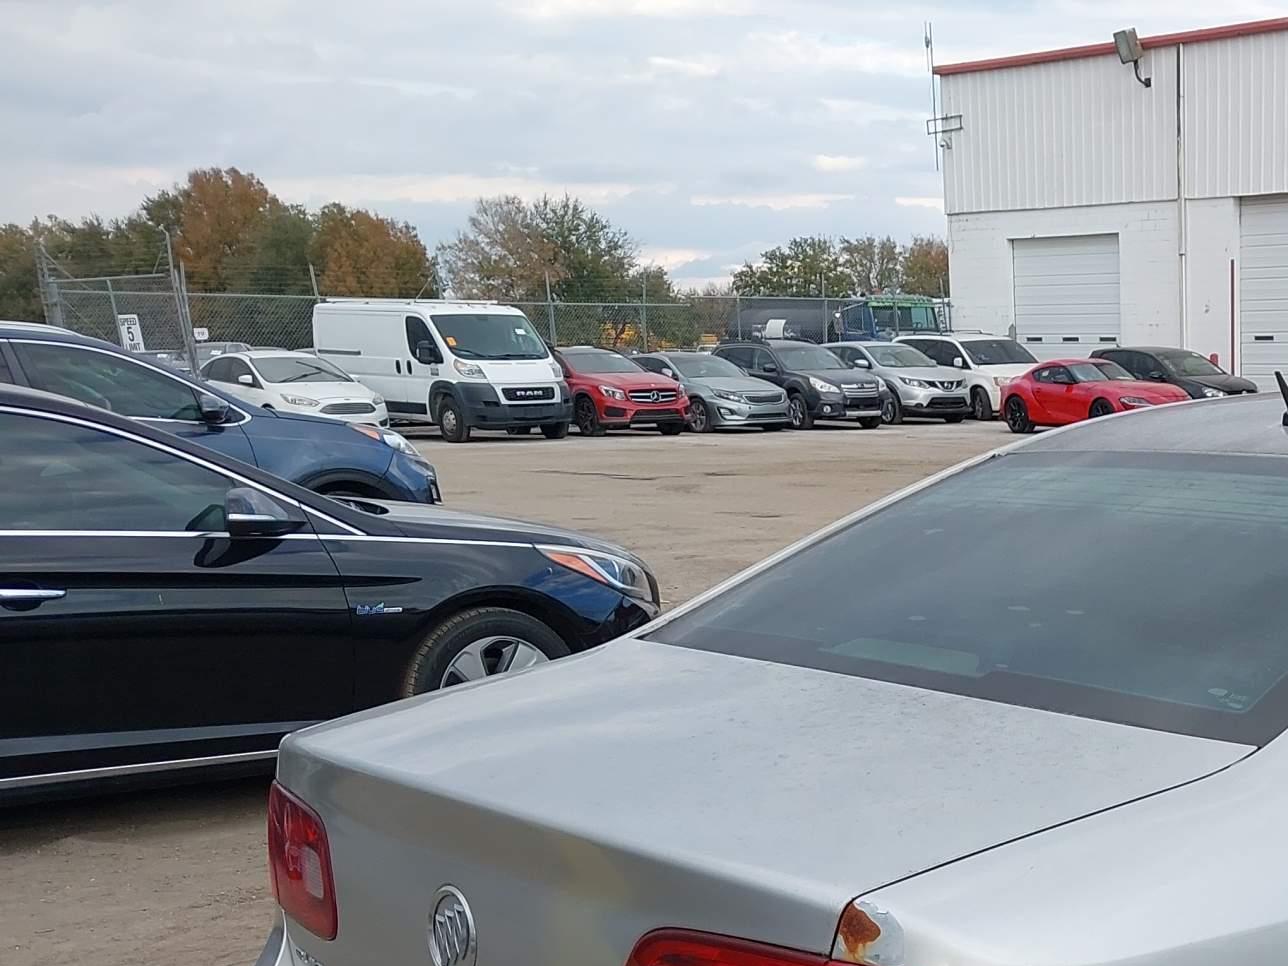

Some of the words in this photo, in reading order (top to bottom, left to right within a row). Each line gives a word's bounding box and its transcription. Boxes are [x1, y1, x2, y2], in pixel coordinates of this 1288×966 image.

[119, 317, 137, 326] SPEED
[126, 326, 135, 342] 5
[516, 389, 544, 397] RAM
